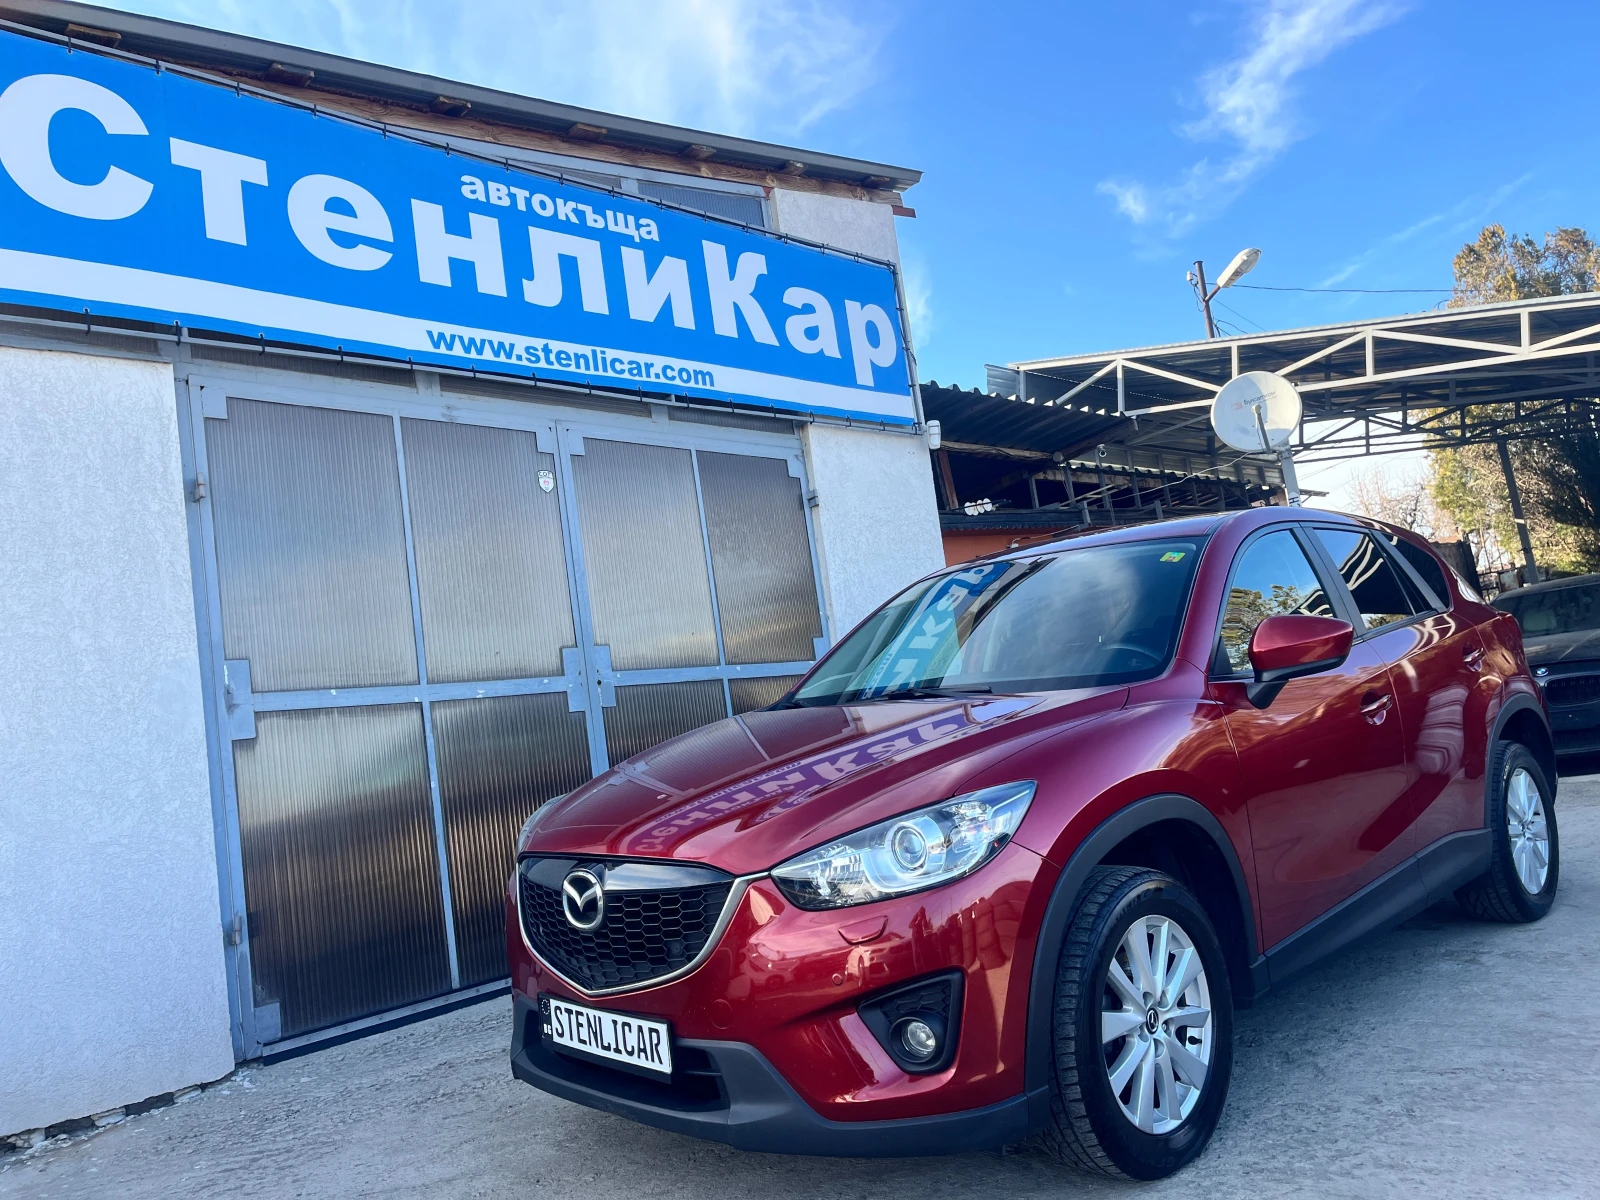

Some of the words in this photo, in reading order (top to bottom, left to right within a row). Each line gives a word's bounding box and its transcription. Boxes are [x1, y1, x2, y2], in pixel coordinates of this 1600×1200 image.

[0, 73, 897, 387] СтенлиКар
[460, 174, 660, 243] автокъща
[425, 329, 715, 388] www.stenlicar.com
[553, 1005, 664, 1065] STENLICAR
